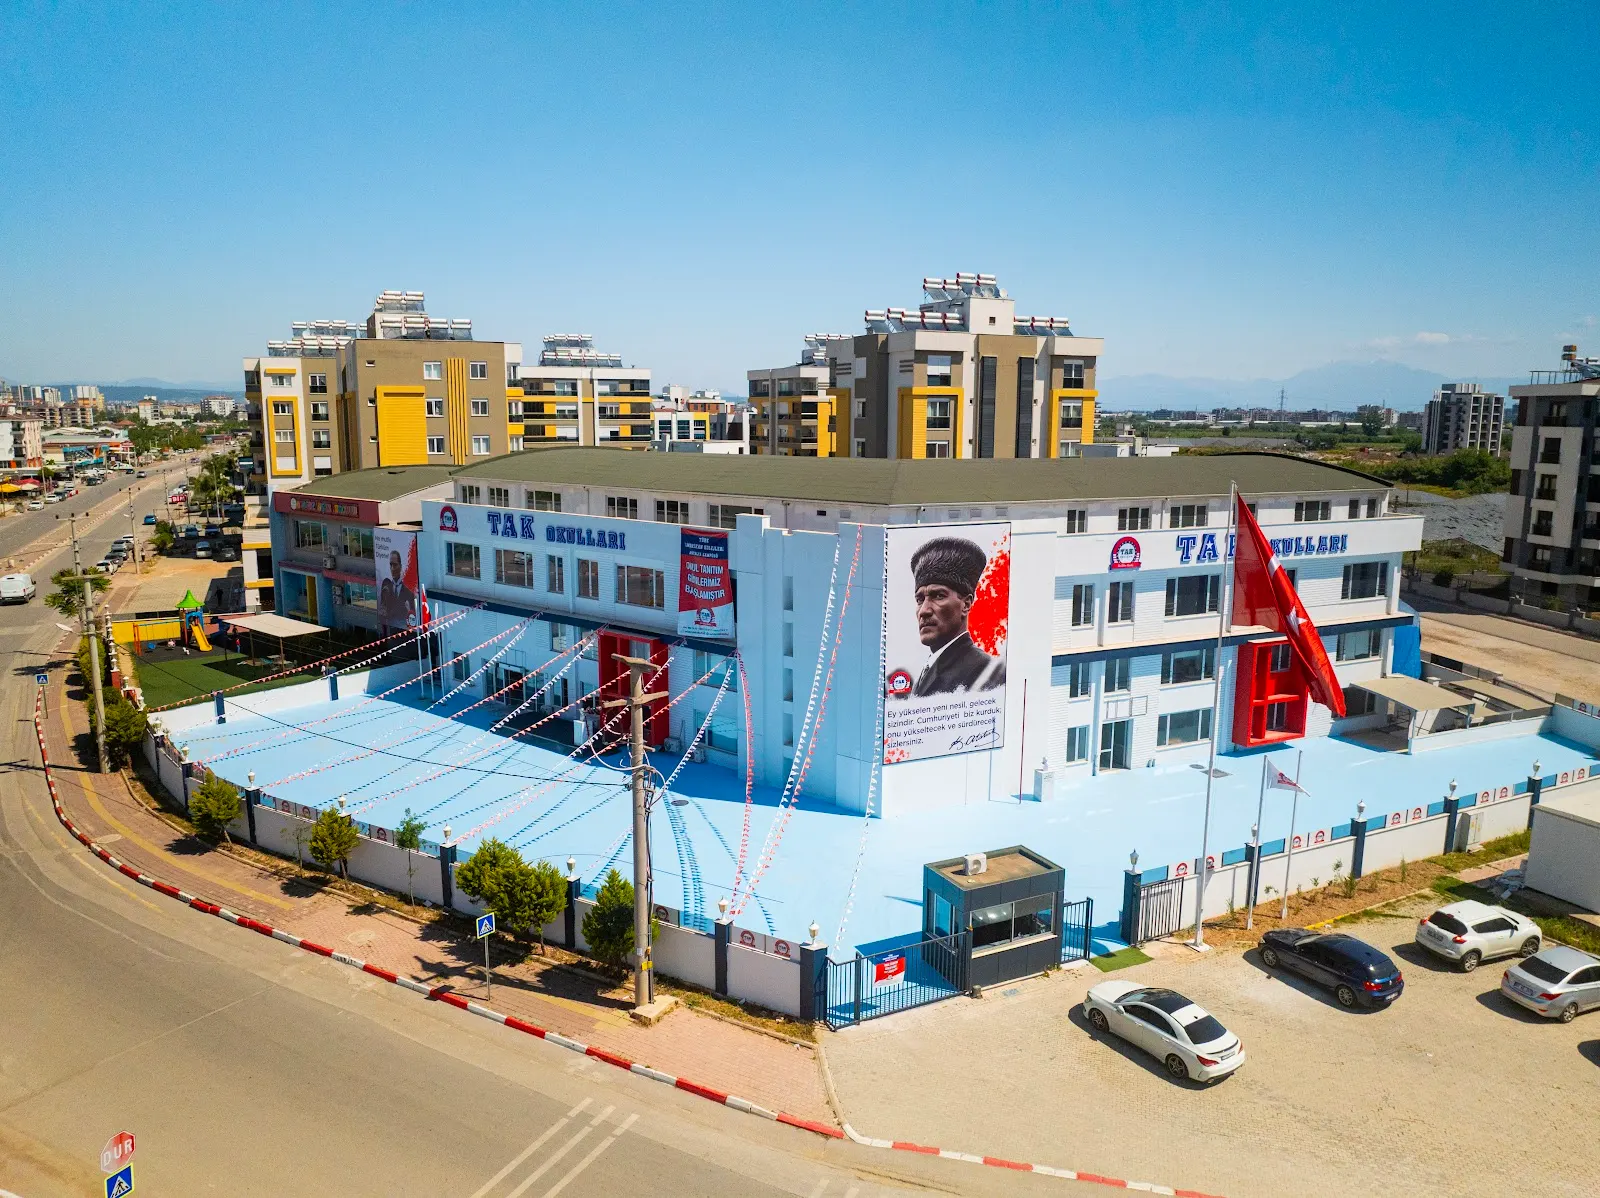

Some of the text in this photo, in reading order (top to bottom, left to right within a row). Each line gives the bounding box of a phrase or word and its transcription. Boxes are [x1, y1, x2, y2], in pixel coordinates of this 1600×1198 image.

[487, 511, 626, 550] TAK OKULLARI
[1270, 534, 1348, 556] KULLARI
[686, 562, 724, 574] OKUL TANITIM
[687, 573, 721, 587] GÜNLERİMİZ
[685, 584, 725, 602] BAŞLAMIŞTIR
[887, 698, 996, 719] Ey yükselen yeni nesil, gelecek
[887, 719, 915, 729] sizindir.
[917, 713, 960, 724] Cumhuriyeti
[976, 707, 1001, 716] kurduk;
[887, 730, 902, 738] onu
[903, 724, 945, 738] yükseltecek
[958, 718, 996, 729] sürdürecek
[887, 738, 923, 748] sizlersiniz.
[103, 1138, 132, 1167] DUR
